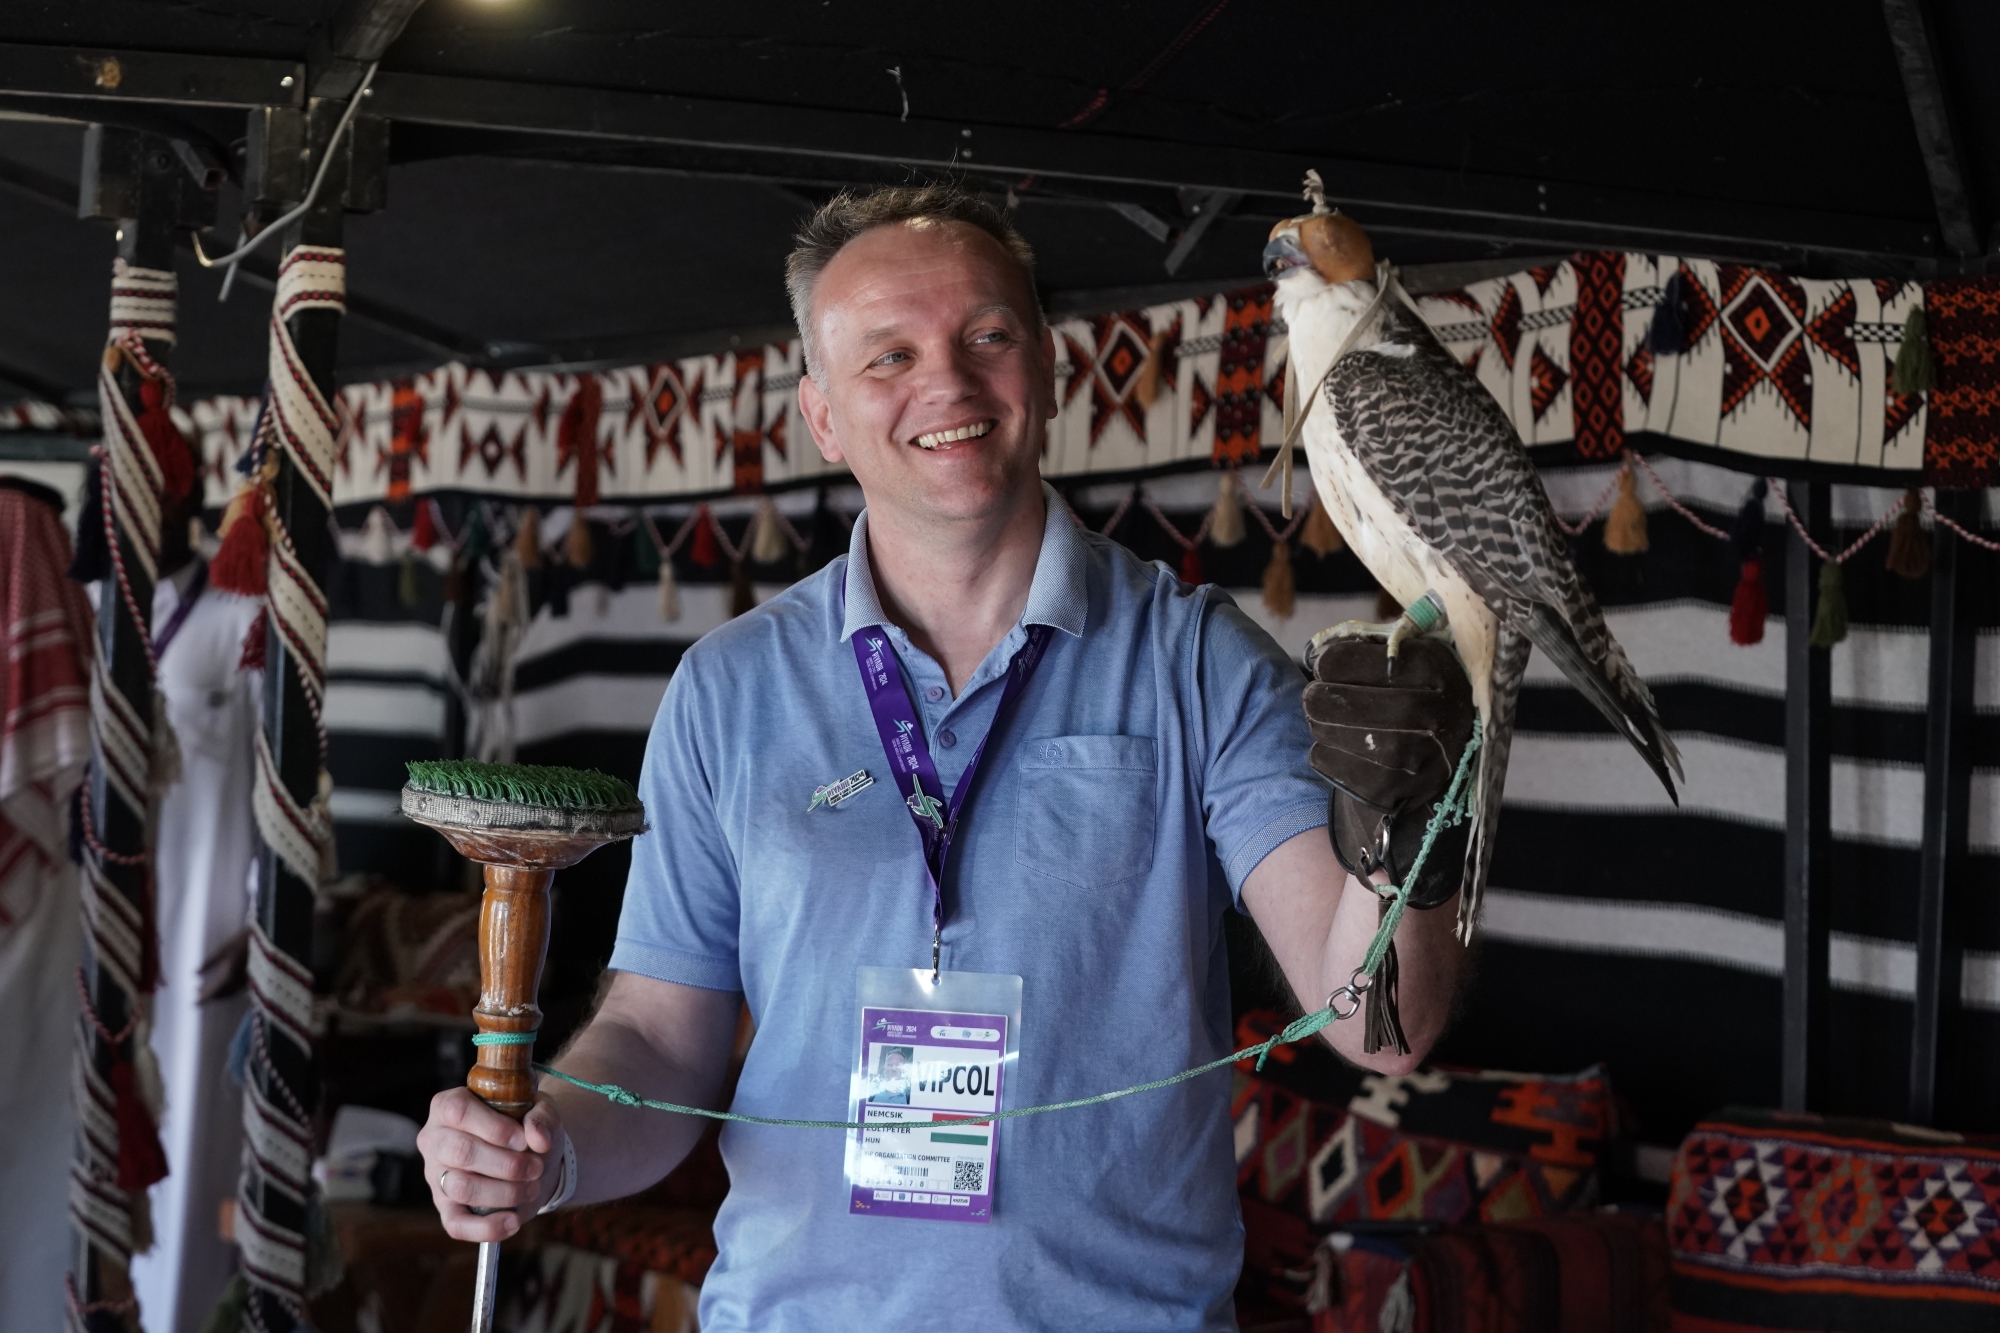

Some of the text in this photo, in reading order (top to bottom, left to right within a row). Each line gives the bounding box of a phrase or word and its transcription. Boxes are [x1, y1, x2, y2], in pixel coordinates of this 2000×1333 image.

[907, 755, 919, 770] 2024
[906, 1025, 917, 1033] 2024
[867, 1110, 903, 1119] NEMCSIK
[918, 1155, 950, 1163] COMMITTEE
